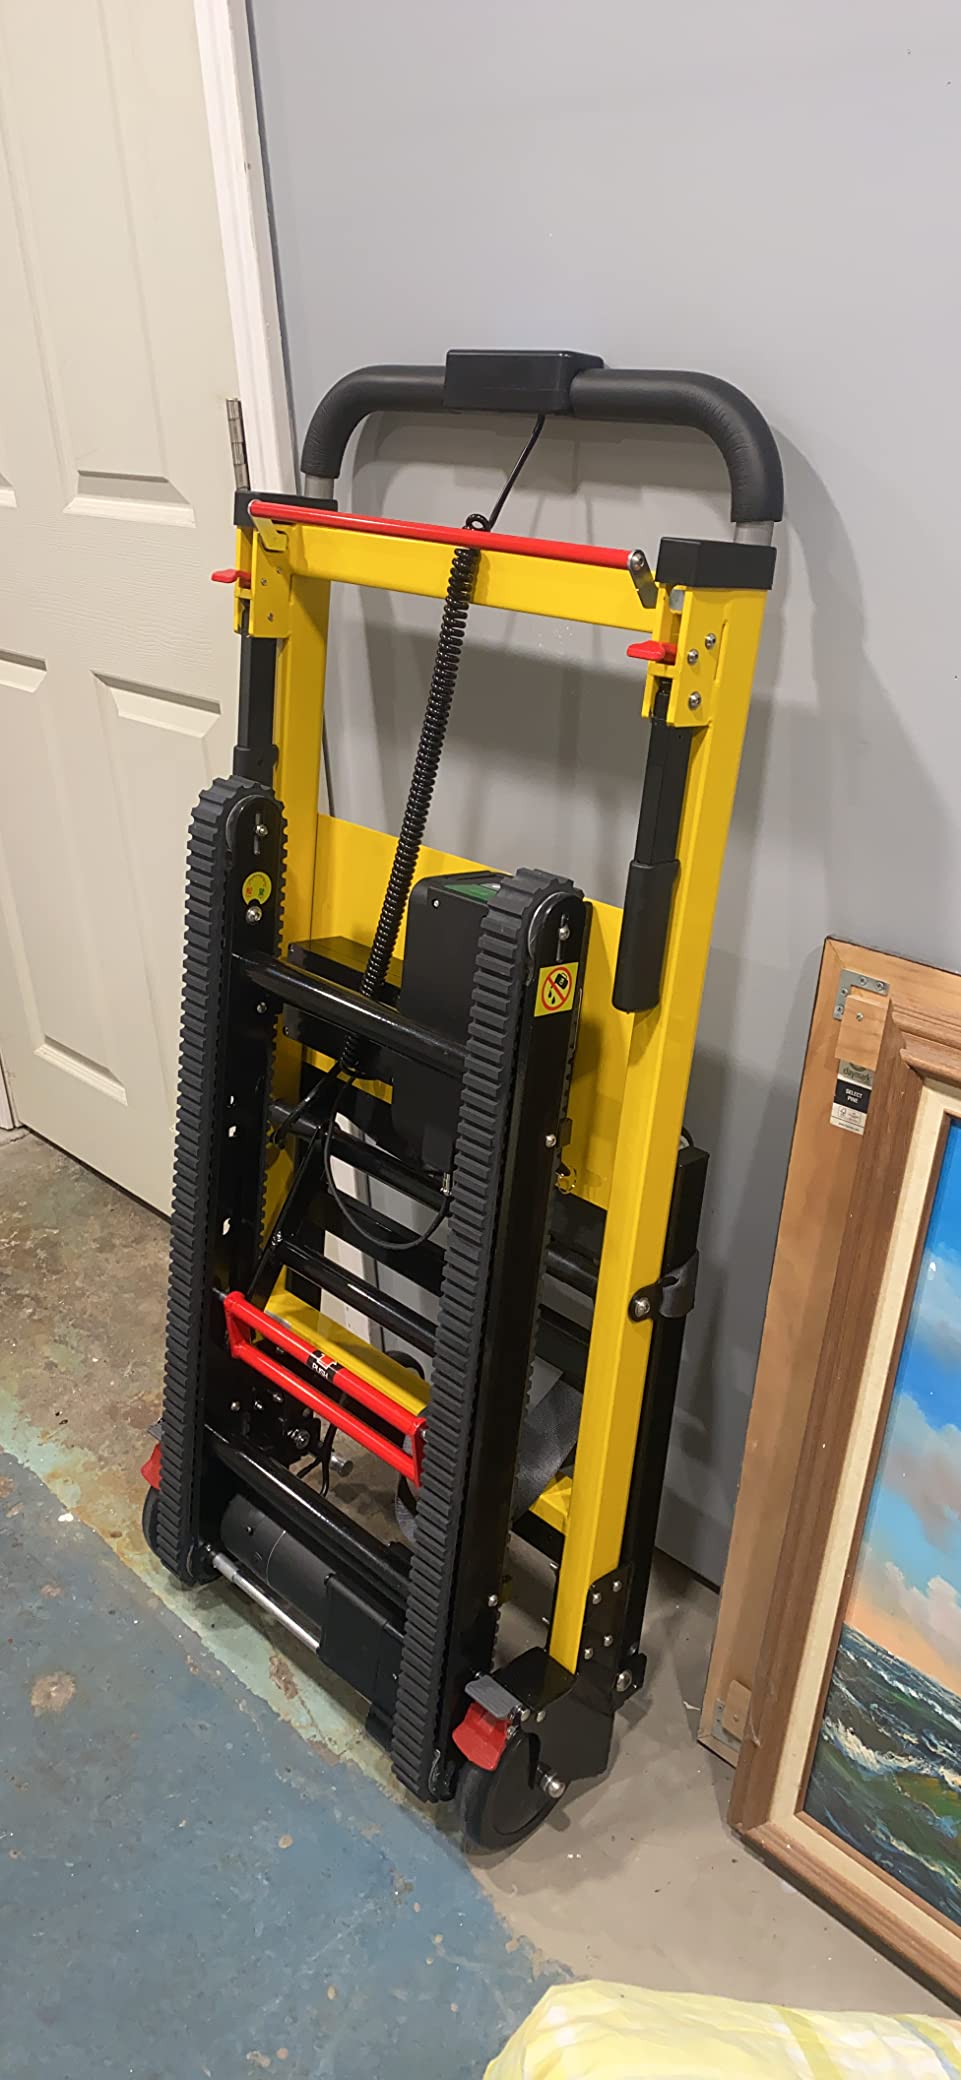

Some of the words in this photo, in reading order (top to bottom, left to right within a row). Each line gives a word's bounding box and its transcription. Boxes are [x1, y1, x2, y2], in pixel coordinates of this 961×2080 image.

[845, 1088, 863, 1099] SELECT
[847, 1095, 859, 1104] PINE
[312, 1362, 329, 1380] PUSH
